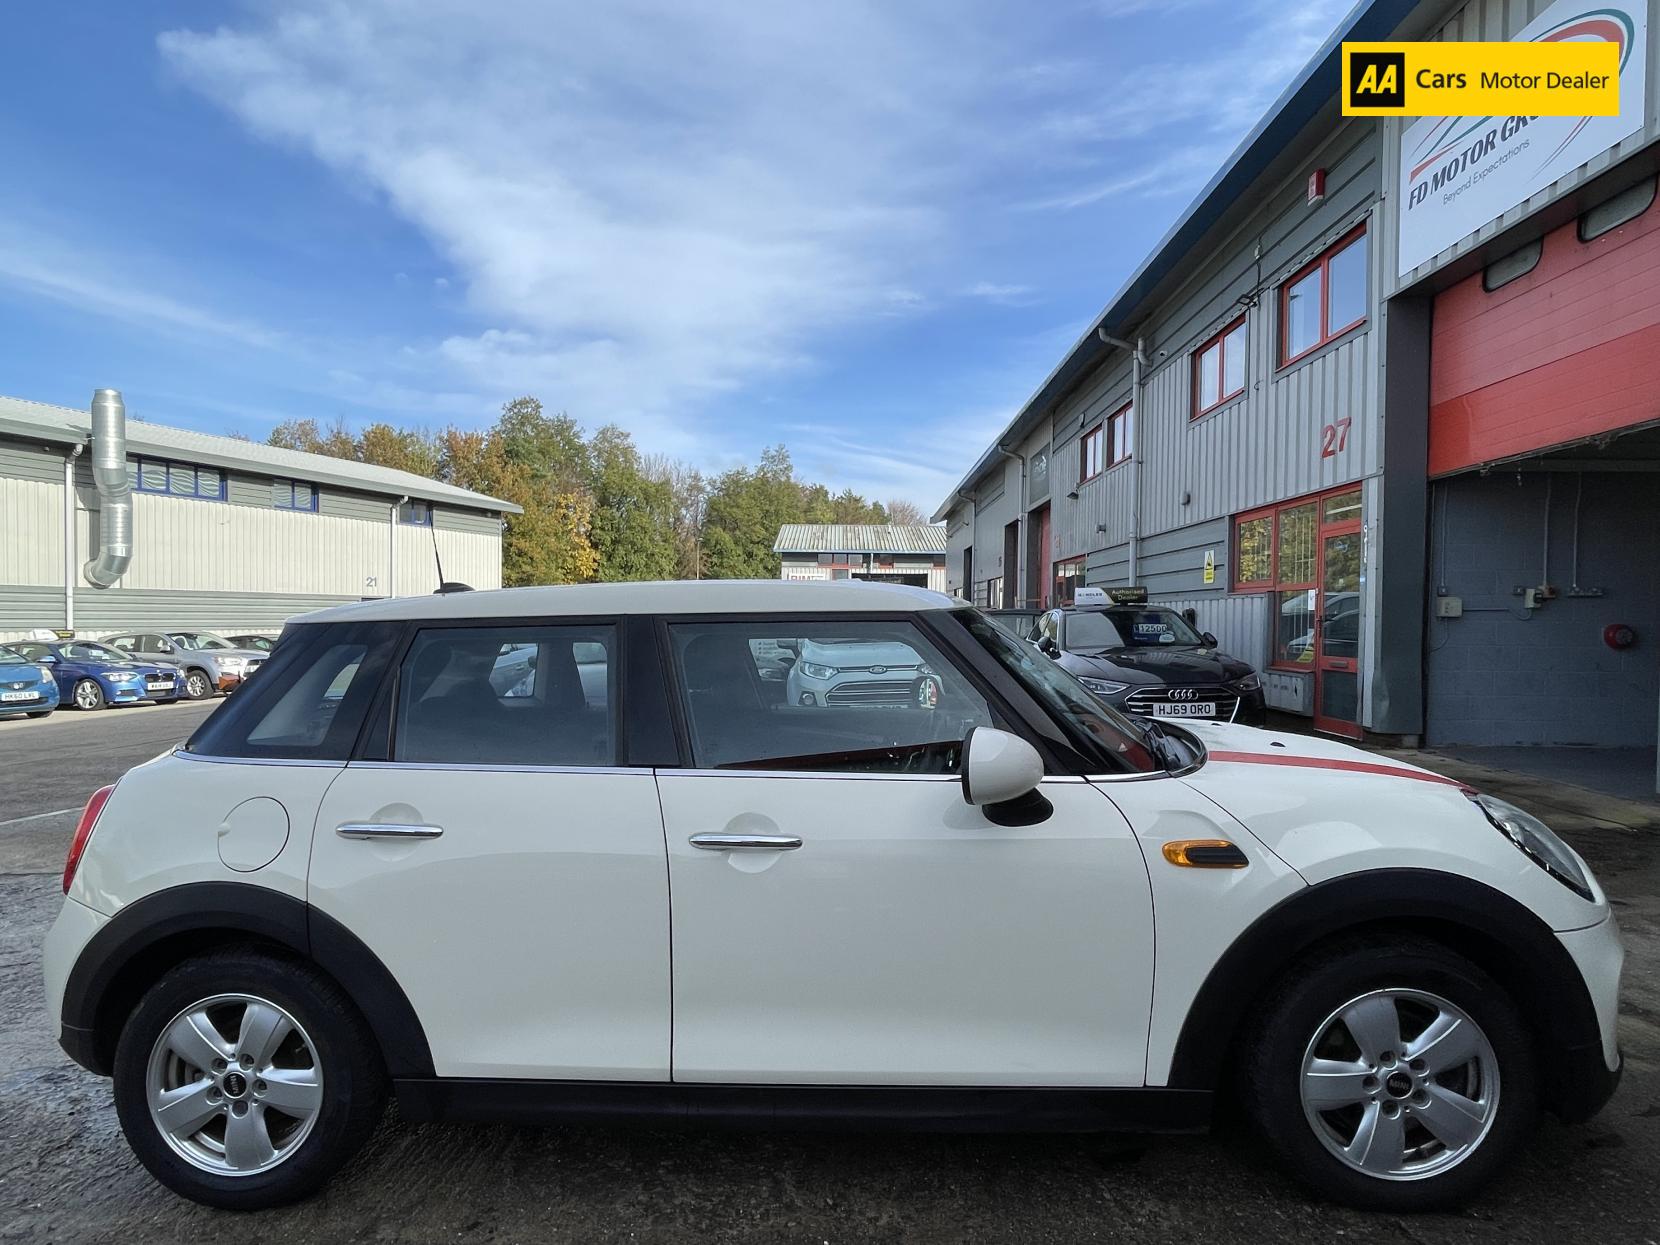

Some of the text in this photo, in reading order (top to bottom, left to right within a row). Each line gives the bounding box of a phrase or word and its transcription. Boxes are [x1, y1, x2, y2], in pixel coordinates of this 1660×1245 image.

[1408, 181, 1428, 211] FD
[1430, 129, 1497, 195] MOTOR
[1443, 138, 1530, 205] Beyond Expectations
[1320, 416, 1352, 459] 27
[366, 576, 377, 588] 21
[1158, 704, 1211, 715] HJ69 ORO
